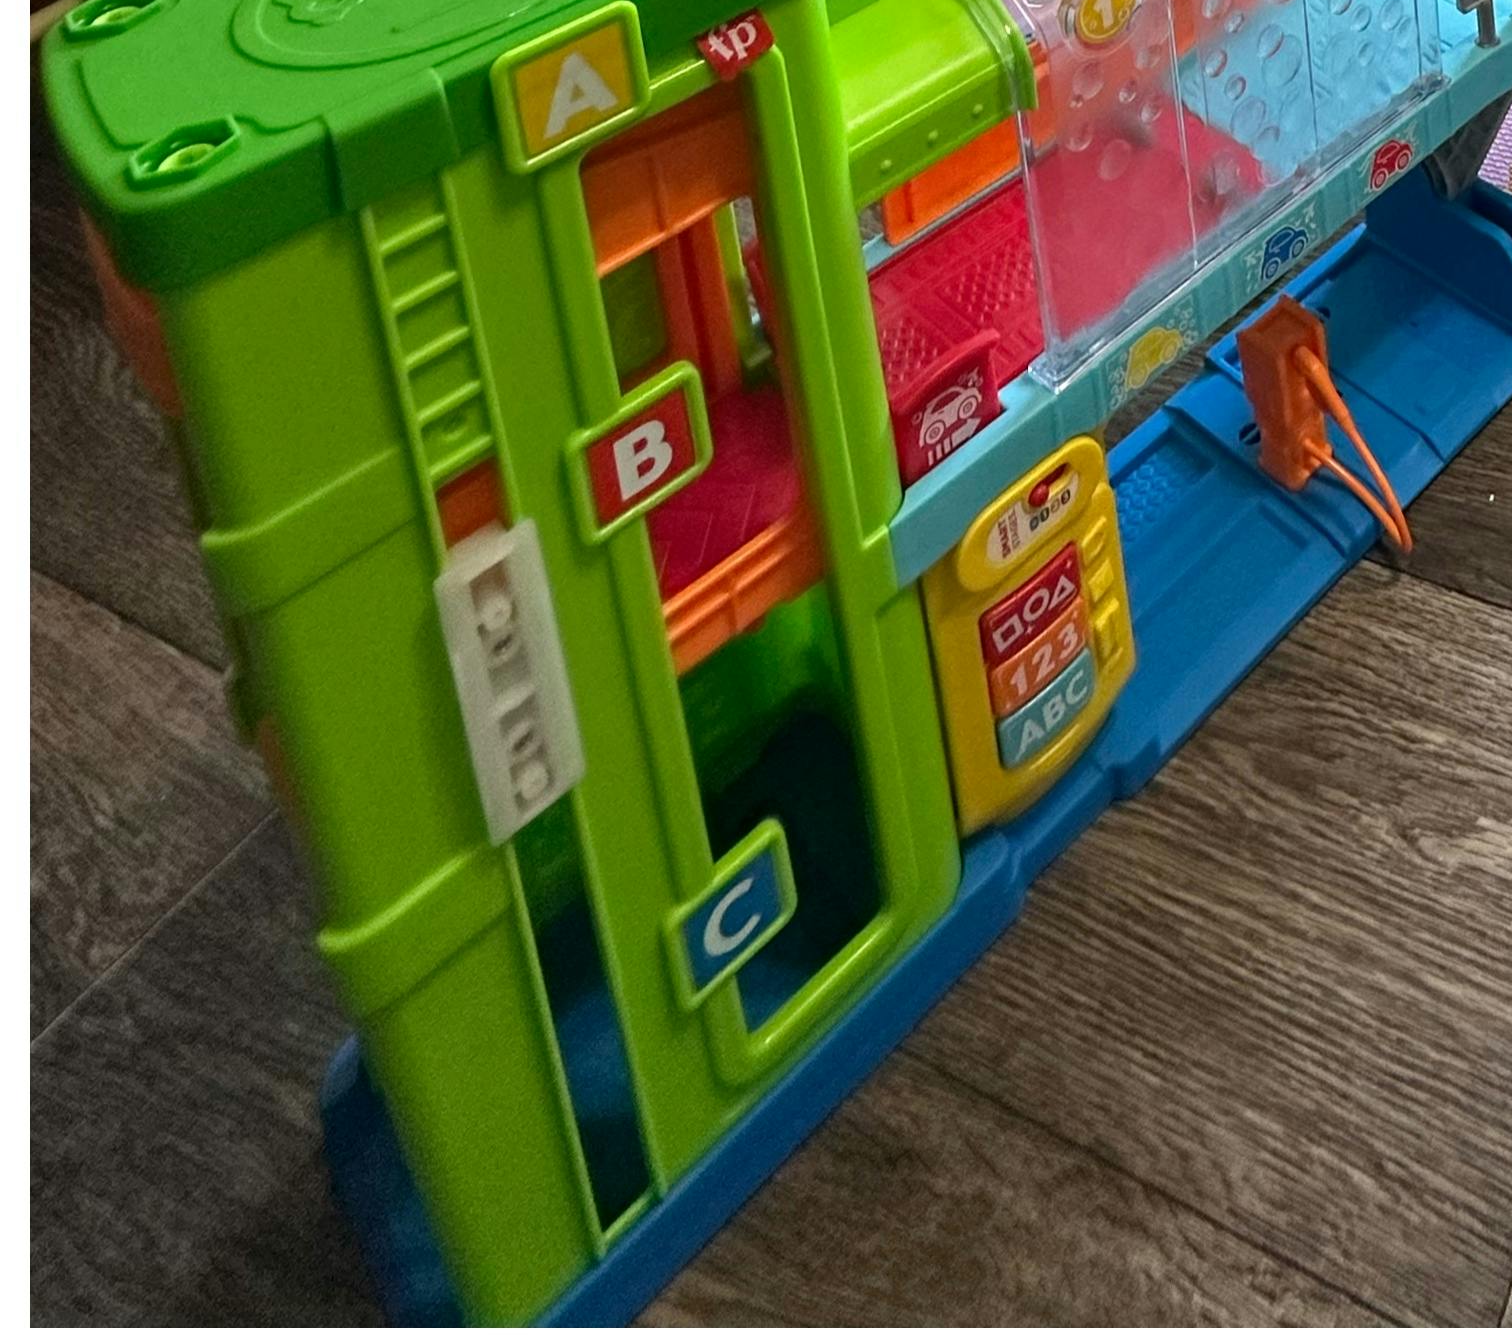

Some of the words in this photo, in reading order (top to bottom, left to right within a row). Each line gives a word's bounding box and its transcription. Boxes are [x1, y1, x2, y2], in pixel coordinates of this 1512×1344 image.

[544, 51, 619, 140] A
[612, 420, 674, 503] B
[1015, 669, 1088, 762] ABC
[703, 876, 762, 957] C
